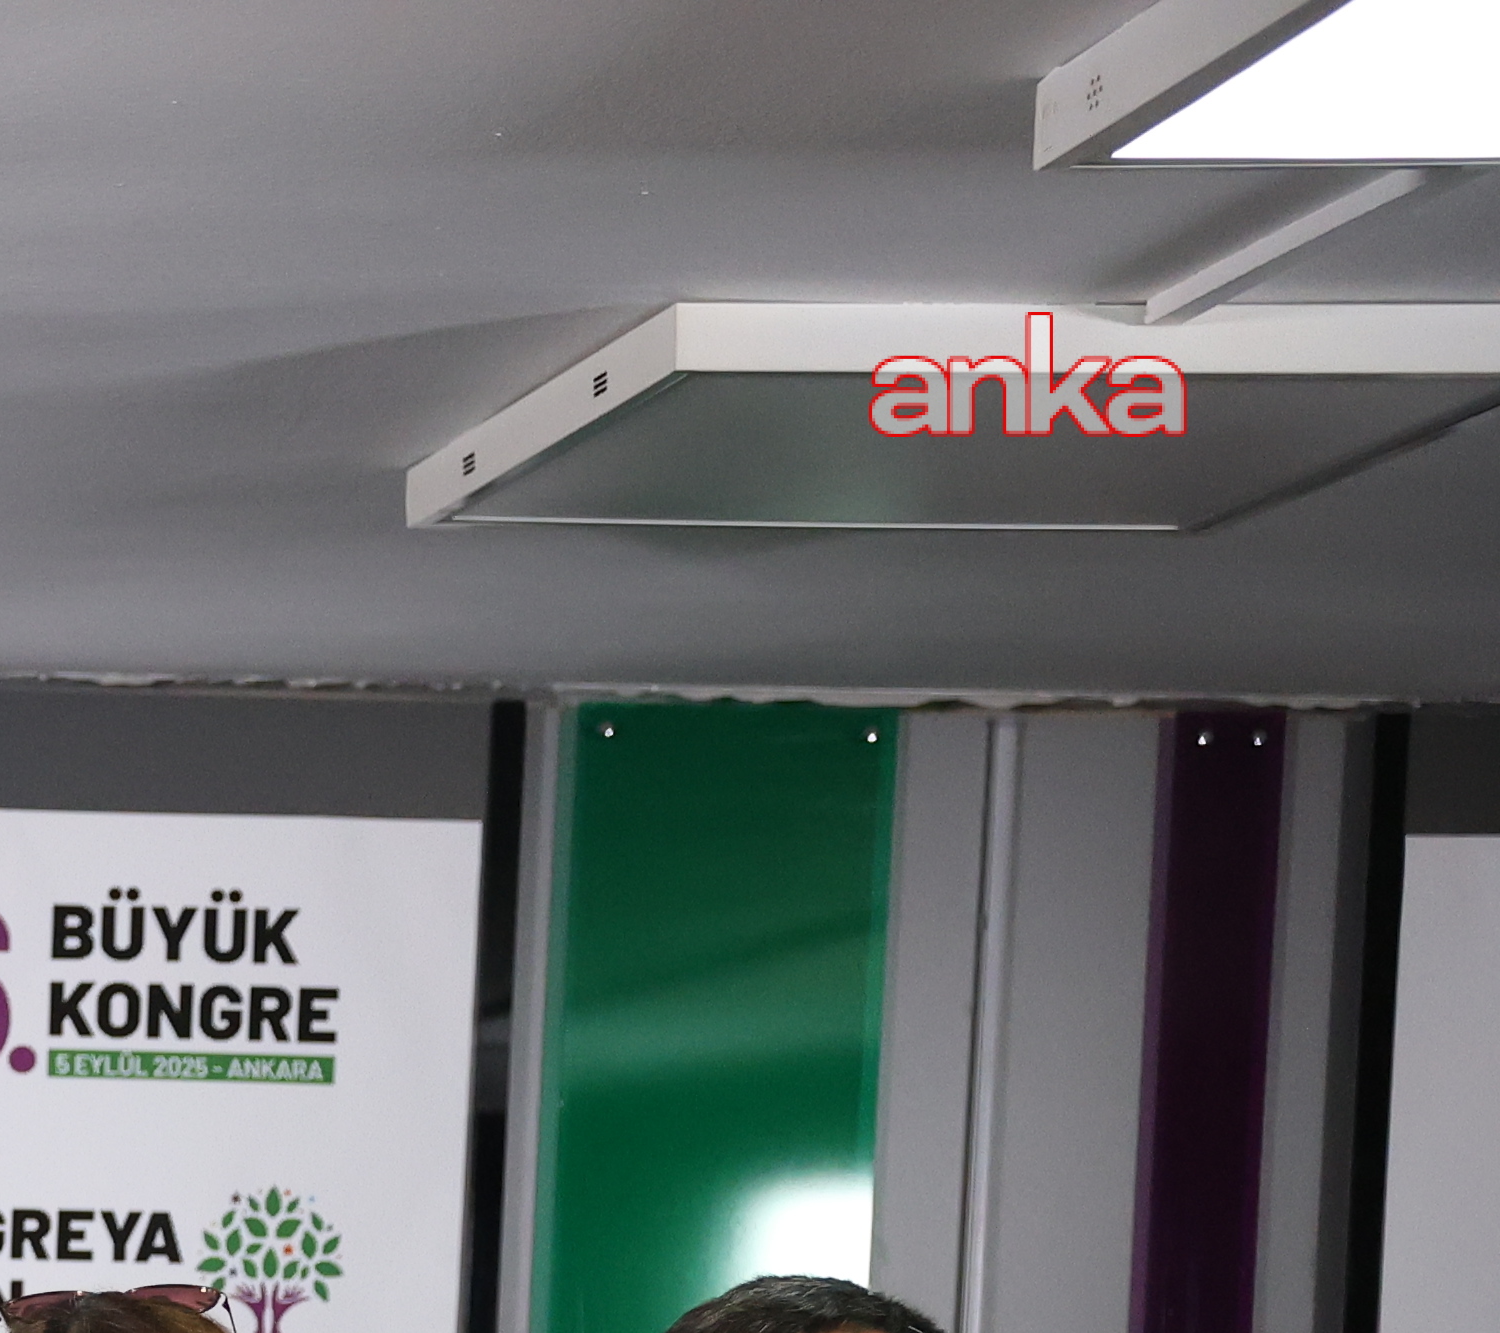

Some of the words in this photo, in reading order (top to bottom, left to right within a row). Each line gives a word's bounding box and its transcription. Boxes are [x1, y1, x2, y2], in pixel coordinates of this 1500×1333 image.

[51, 886, 300, 965] BÜYÜK
[49, 981, 340, 1044] KONGRE
[54, 1053, 70, 1076] 5
[74, 1049, 148, 1078] EYLÜL
[152, 1056, 209, 1080] 2025
[226, 1057, 324, 1082] ANKARA
